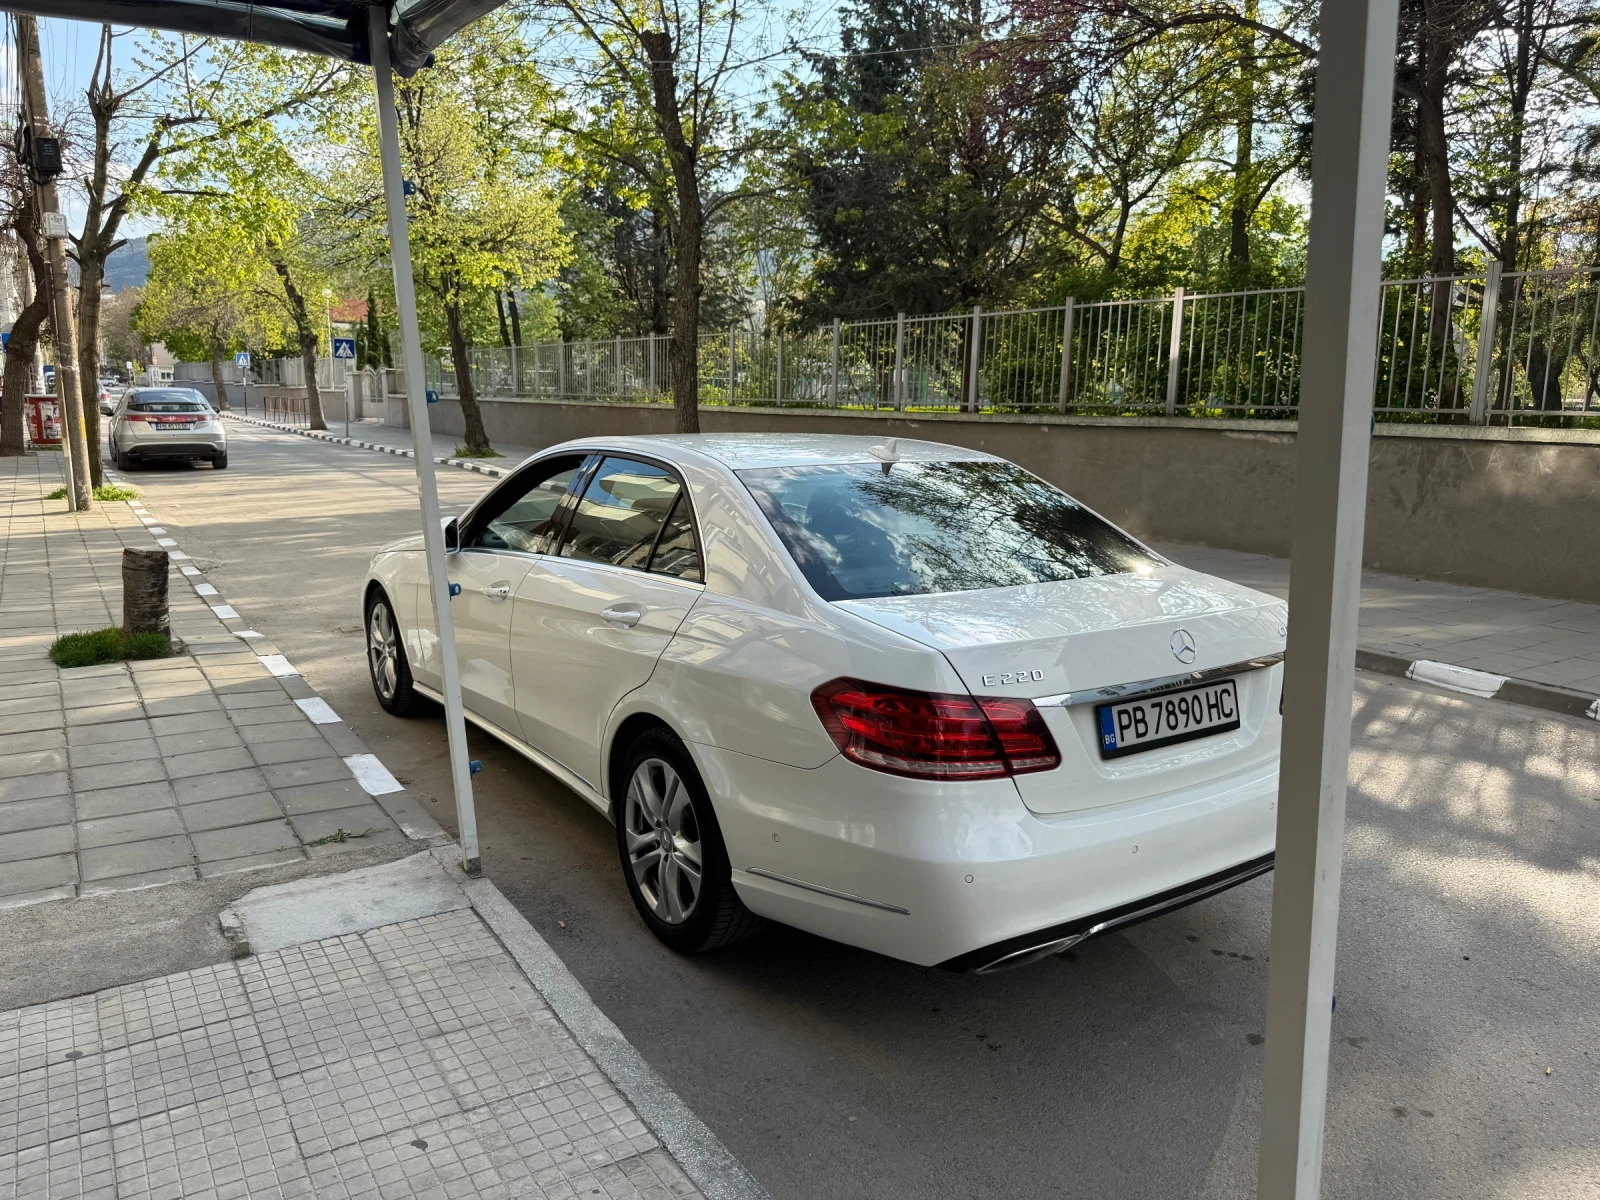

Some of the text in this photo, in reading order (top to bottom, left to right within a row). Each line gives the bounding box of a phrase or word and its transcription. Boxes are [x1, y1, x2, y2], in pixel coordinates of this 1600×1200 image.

[981, 669, 1044, 687] E 220
[1117, 688, 1234, 742] PB 7890 HC
[1105, 733, 1116, 745] BG
